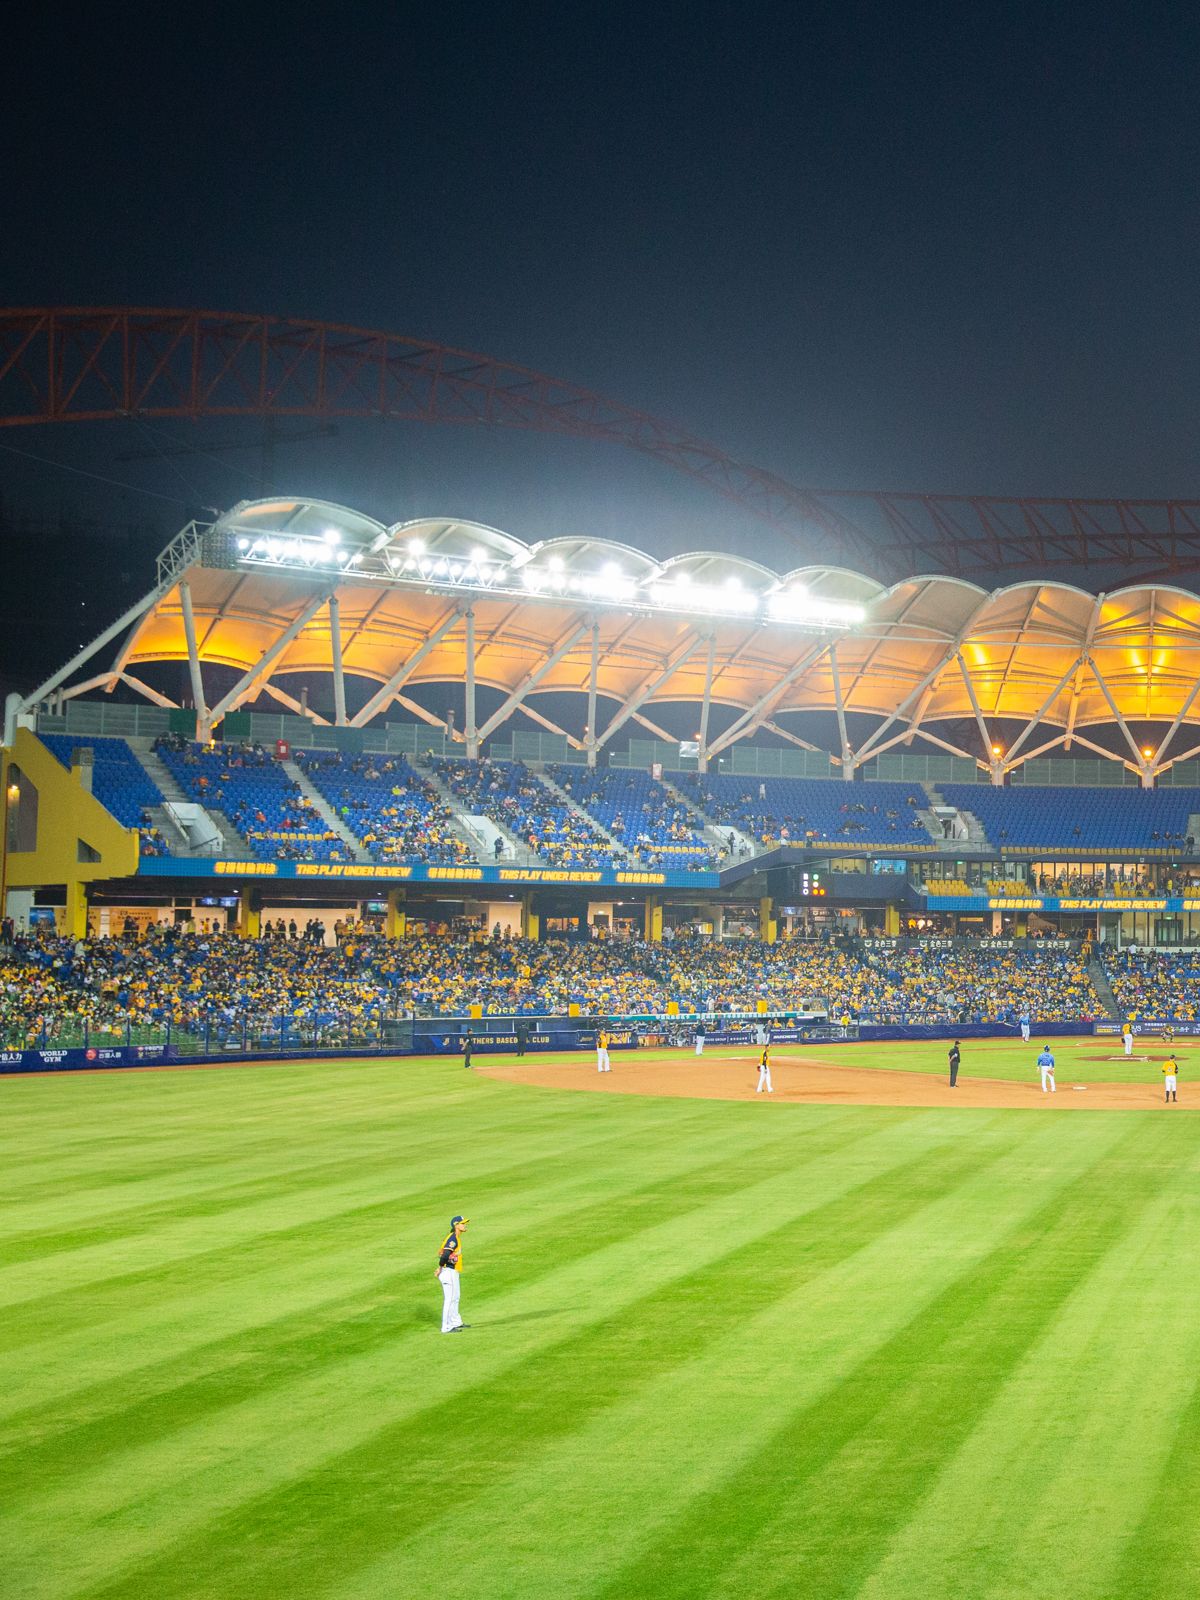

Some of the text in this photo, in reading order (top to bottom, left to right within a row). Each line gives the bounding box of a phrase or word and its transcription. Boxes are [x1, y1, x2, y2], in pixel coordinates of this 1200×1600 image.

[296, 864, 412, 878] THIS PLAY UNDER REVIEW
[500, 869, 602, 882] THIS PLAY UNDER REVIEW
[1060, 900, 1167, 909] THIS PLAY UNDER REVIEW
